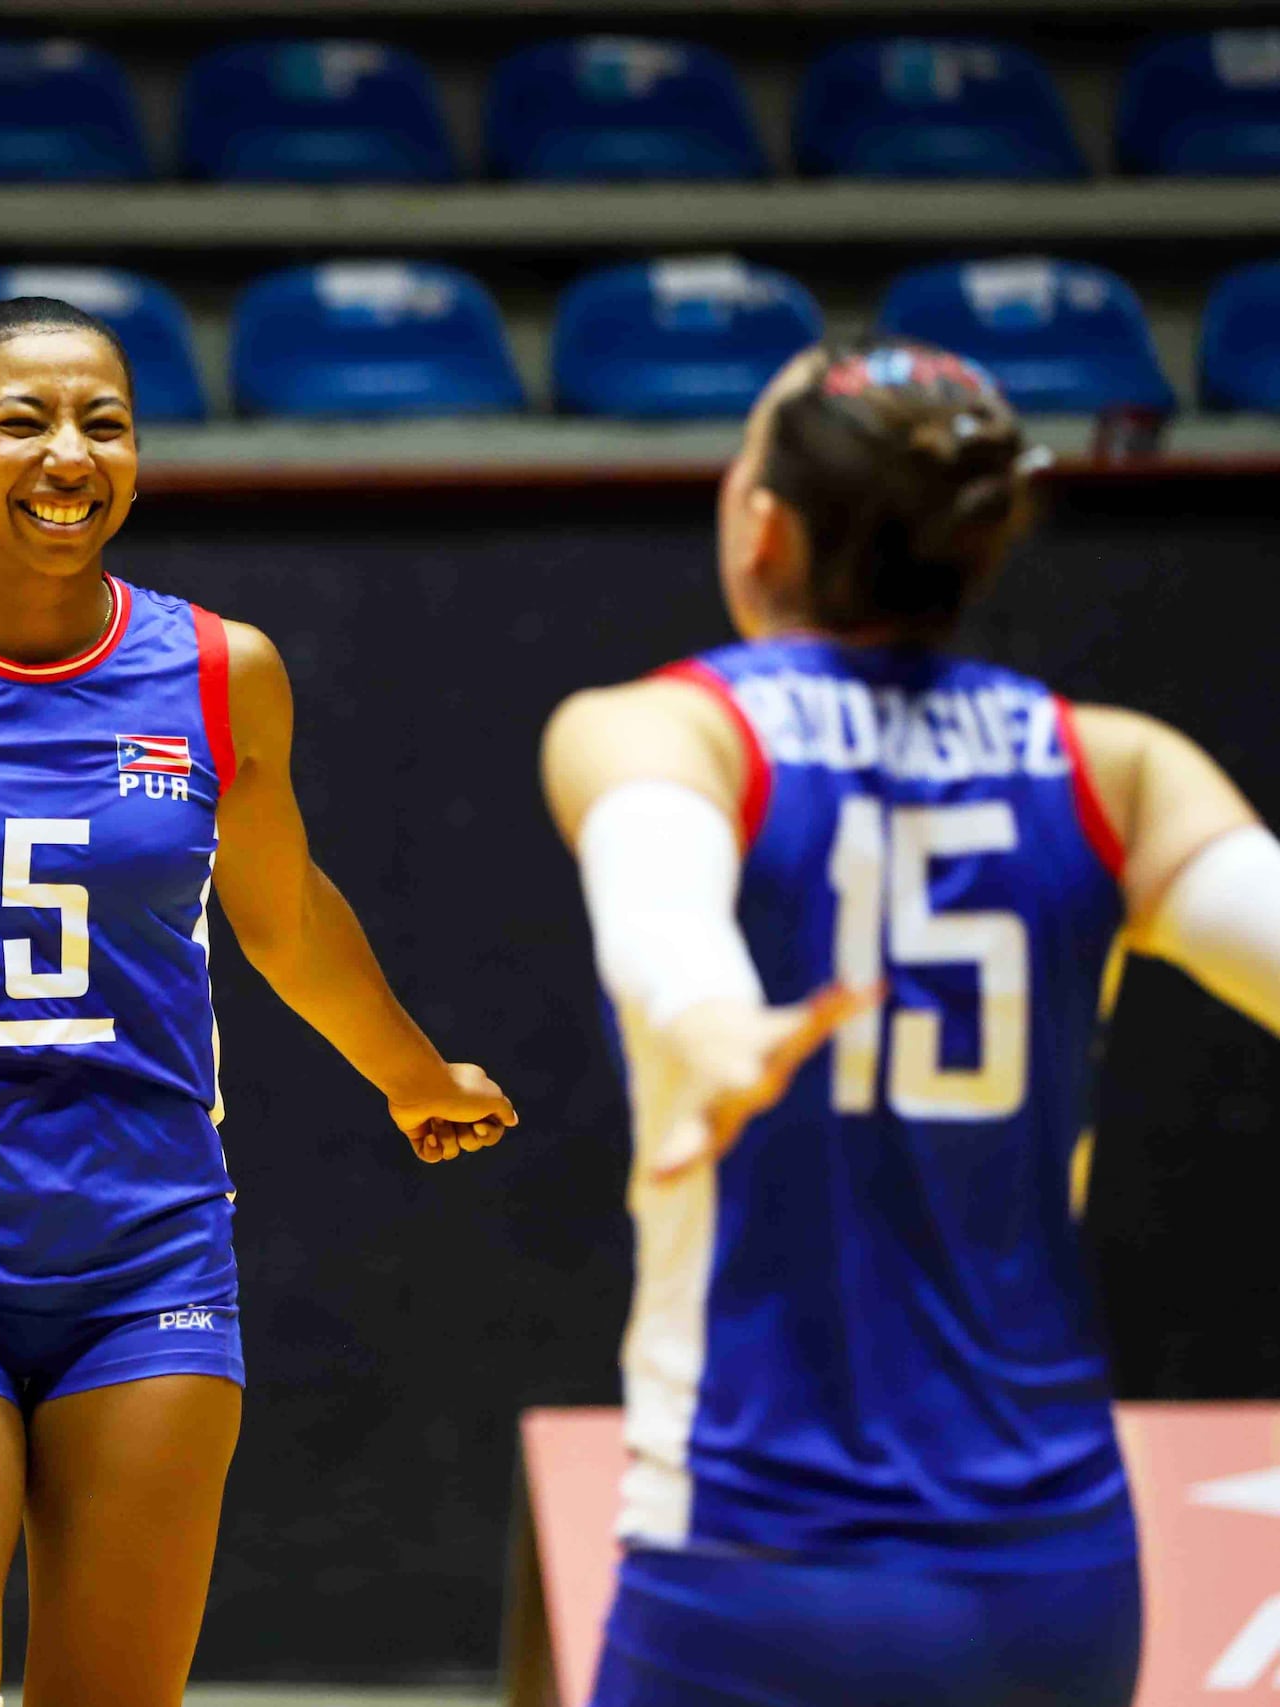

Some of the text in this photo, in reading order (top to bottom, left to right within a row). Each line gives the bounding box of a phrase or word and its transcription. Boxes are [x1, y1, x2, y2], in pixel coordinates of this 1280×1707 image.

[118, 771, 190, 802] PUR
[1, 817, 91, 1000] 5
[827, 793, 1030, 1121] 15
[158, 1310, 215, 1332] PEAK
